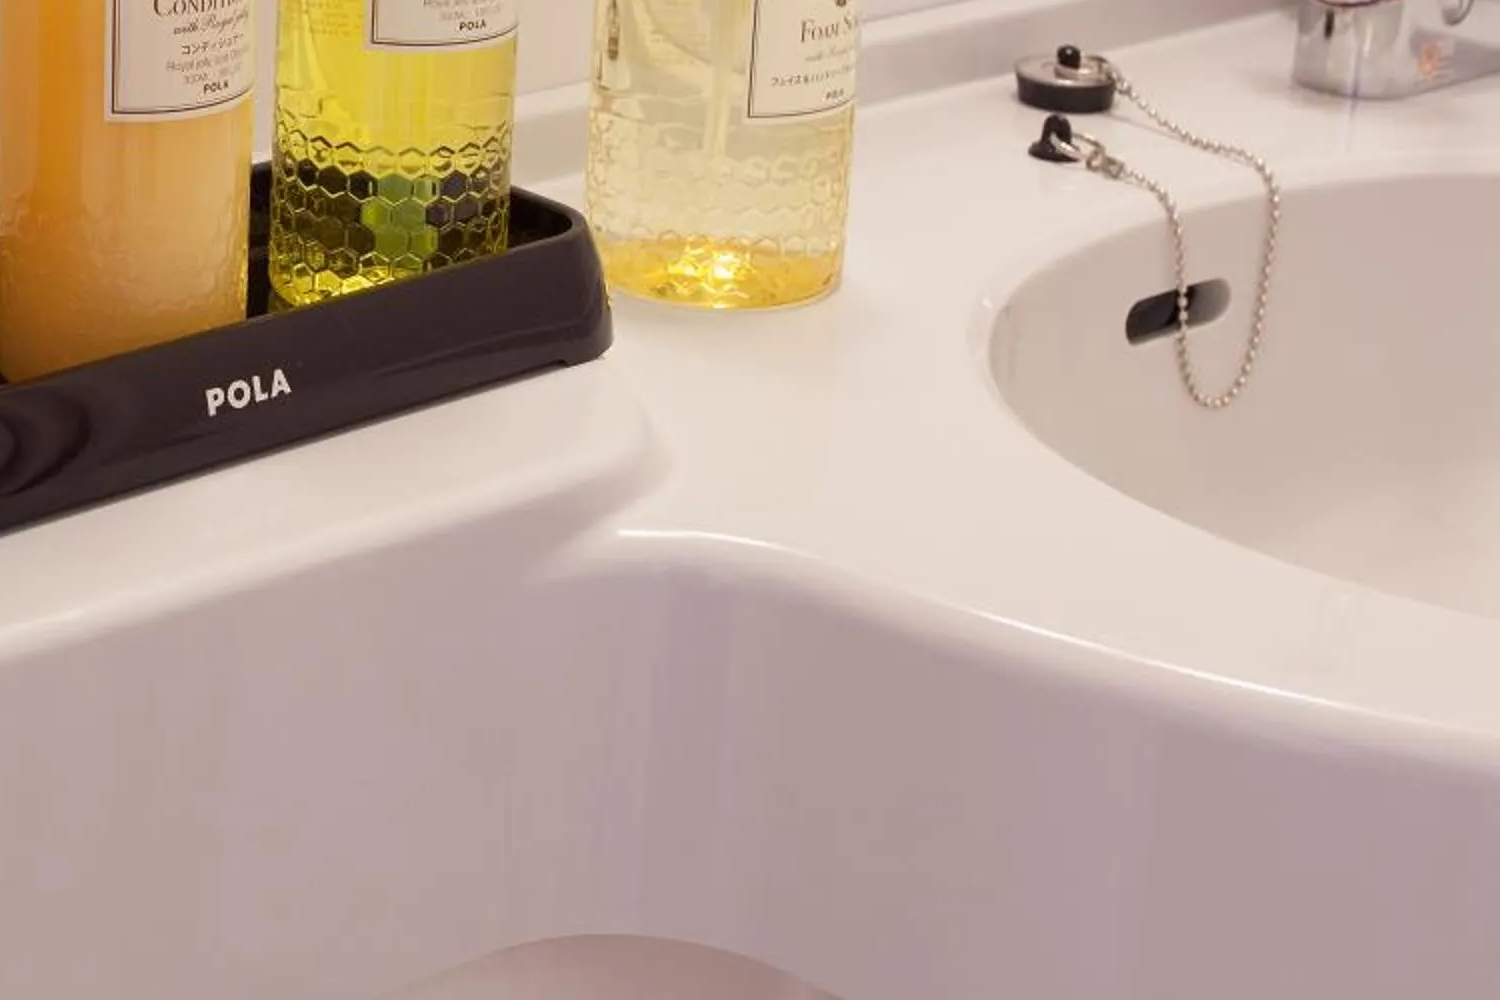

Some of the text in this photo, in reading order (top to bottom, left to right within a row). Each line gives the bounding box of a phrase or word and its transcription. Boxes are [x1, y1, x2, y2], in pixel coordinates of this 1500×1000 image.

[459, 19, 487, 31] POLA
[203, 80, 228, 94] POLA
[205, 367, 292, 417] POLA
